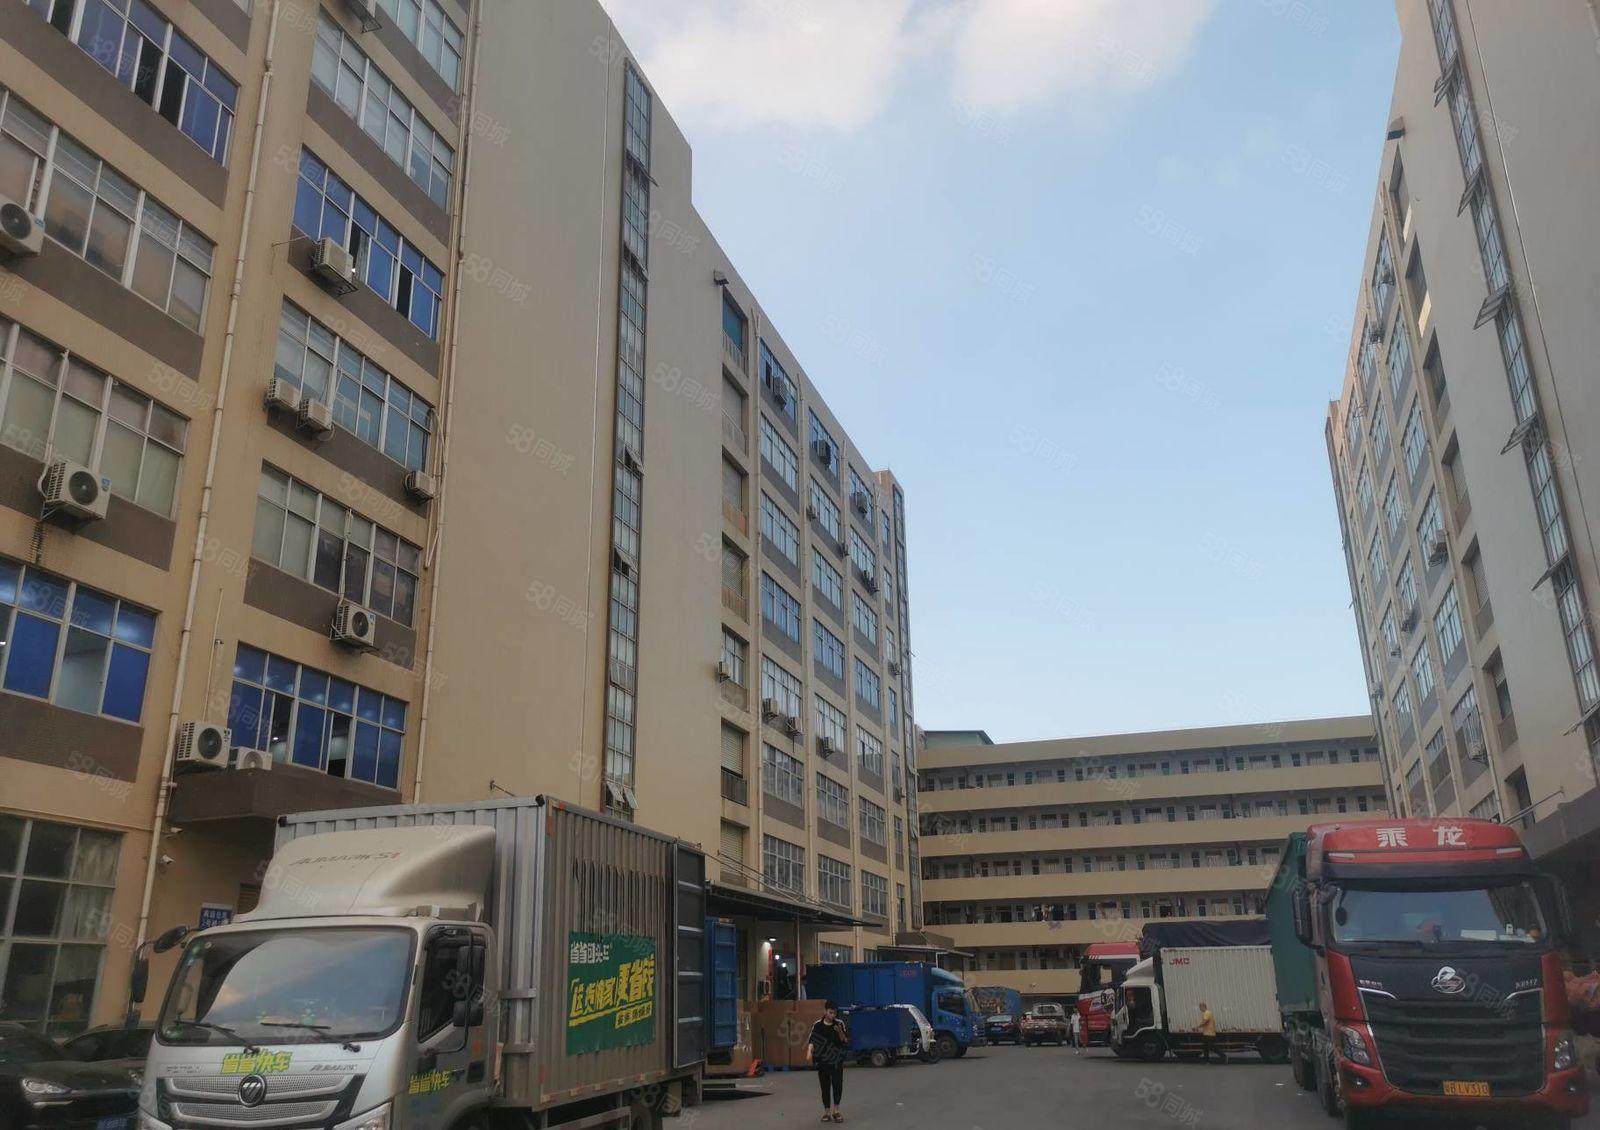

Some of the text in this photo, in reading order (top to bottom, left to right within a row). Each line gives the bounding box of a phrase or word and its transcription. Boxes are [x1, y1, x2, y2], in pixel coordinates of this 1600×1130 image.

[1376, 825, 1467, 848] 乘龙
[1169, 957, 1191, 965] JMC
[220, 1050, 293, 1074] 省省快车
[408, 1069, 449, 1095] 省省快车
